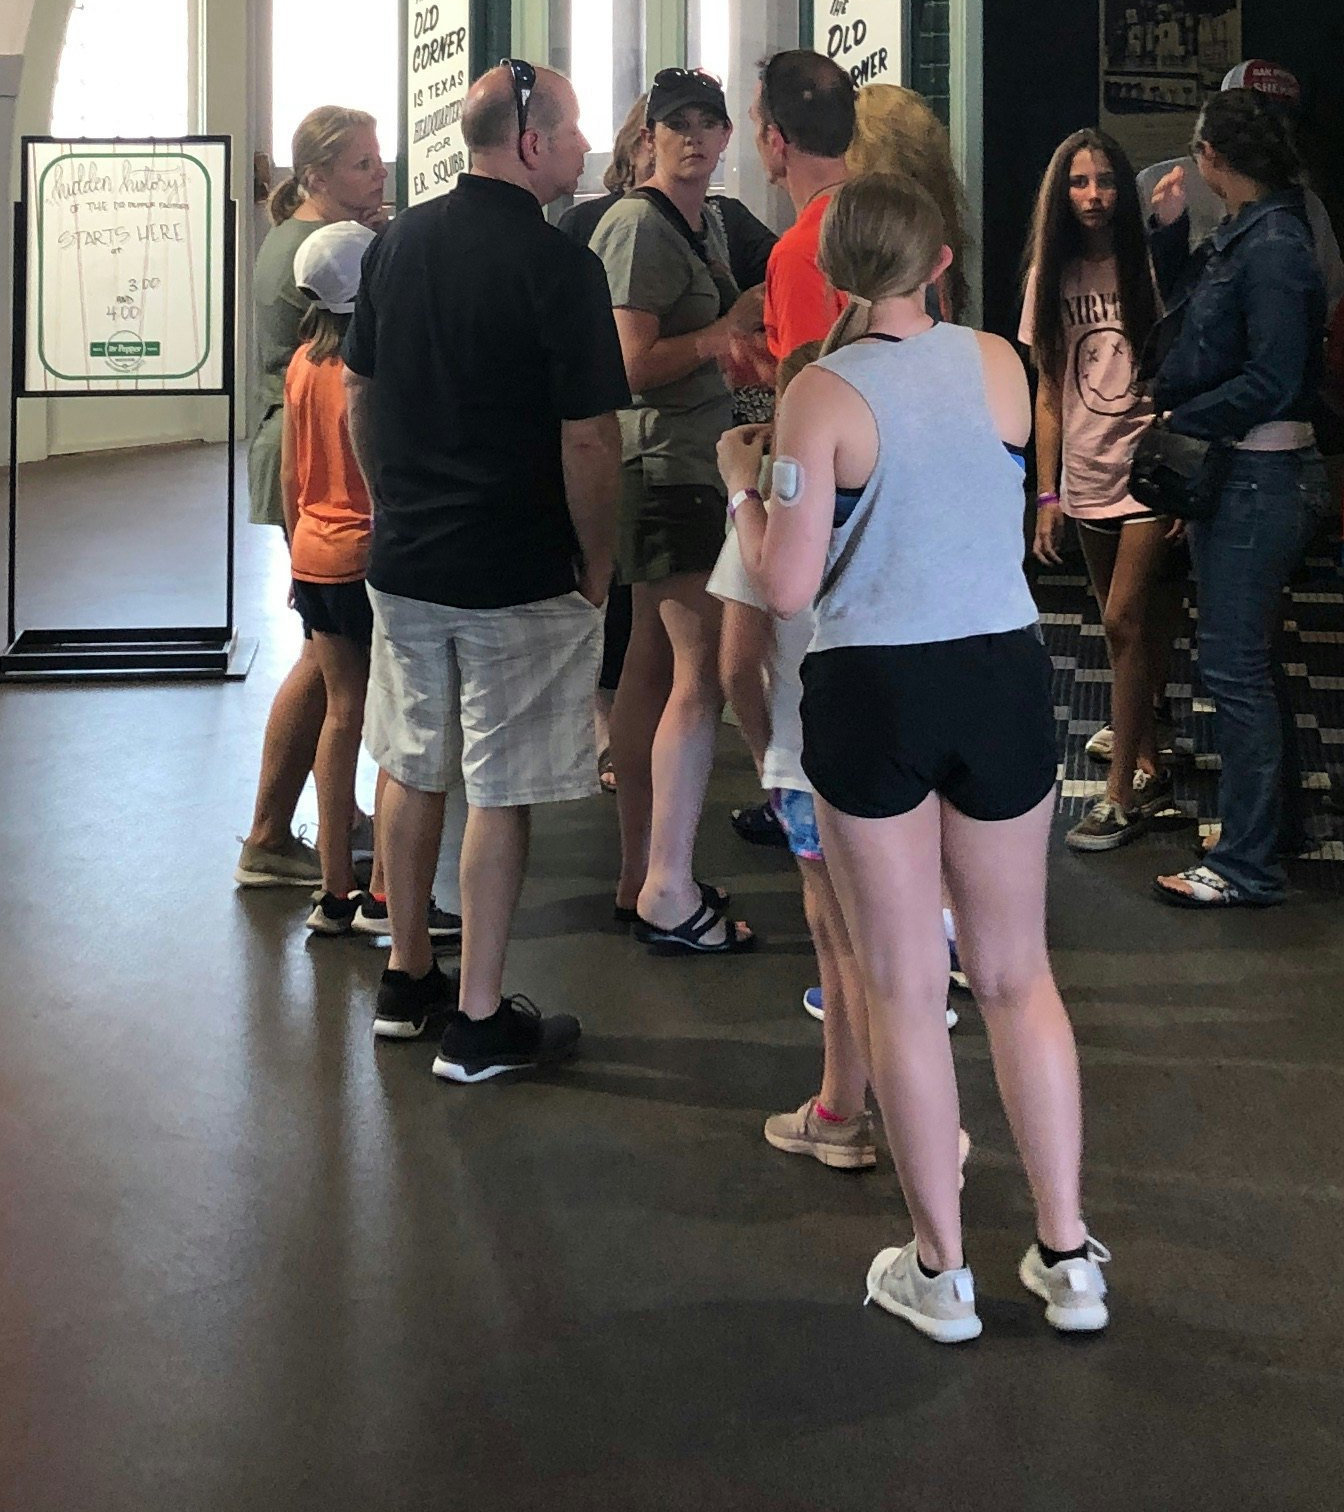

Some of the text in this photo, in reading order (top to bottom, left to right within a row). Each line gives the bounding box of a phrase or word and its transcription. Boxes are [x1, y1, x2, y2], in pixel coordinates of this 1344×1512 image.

[414, 4, 439, 39] OLD
[827, 19, 867, 59] OLD
[413, 27, 466, 73] CORNER
[850, 47, 888, 89] RNER
[414, 70, 464, 108] IS TEXAS
[426, 137, 451, 158] FOR
[433, 151, 465, 185] SQUIBB
[57, 223, 184, 250] STARTS HERE
